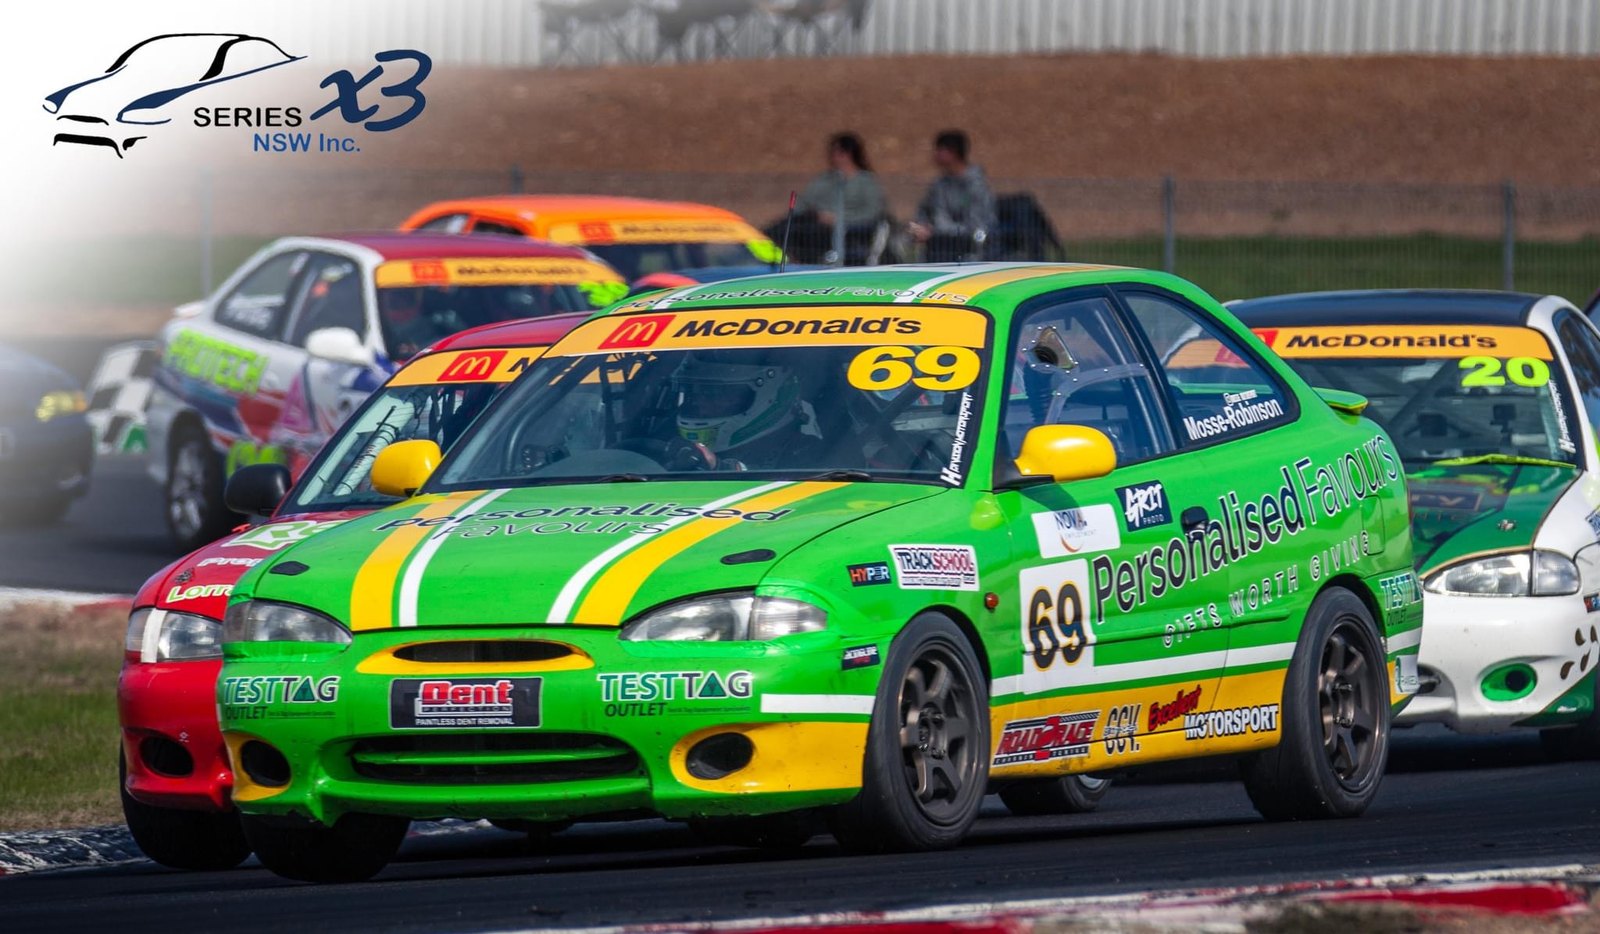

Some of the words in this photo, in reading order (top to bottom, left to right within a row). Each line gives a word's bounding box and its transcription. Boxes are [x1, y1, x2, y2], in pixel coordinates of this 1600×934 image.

[673, 316, 921, 338] McDonald's
[1285, 332, 1497, 349] McDonald's
[847, 345, 981, 391] 69
[1458, 355, 1550, 387] 20
[1182, 399, 1284, 440] Mosse-Robinson
[1125, 484, 1163, 527] GRIT
[1143, 514, 1164, 525] PHOTO
[850, 565, 890, 583] HYPER
[1163, 602, 1222, 648] GIFTS
[1228, 564, 1299, 617] WORTH
[1310, 530, 1369, 582] GIVING
[1029, 579, 1088, 672] 69
[418, 679, 514, 706] Dent
[225, 706, 268, 720] OUTLET
[415, 717, 456, 726] PAINTLESS
[457, 717, 476, 725] DENT
[477, 717, 514, 725] REMOVAL
[604, 702, 667, 717] OUTLET
[1184, 703, 1279, 740] MOTORSPORT
